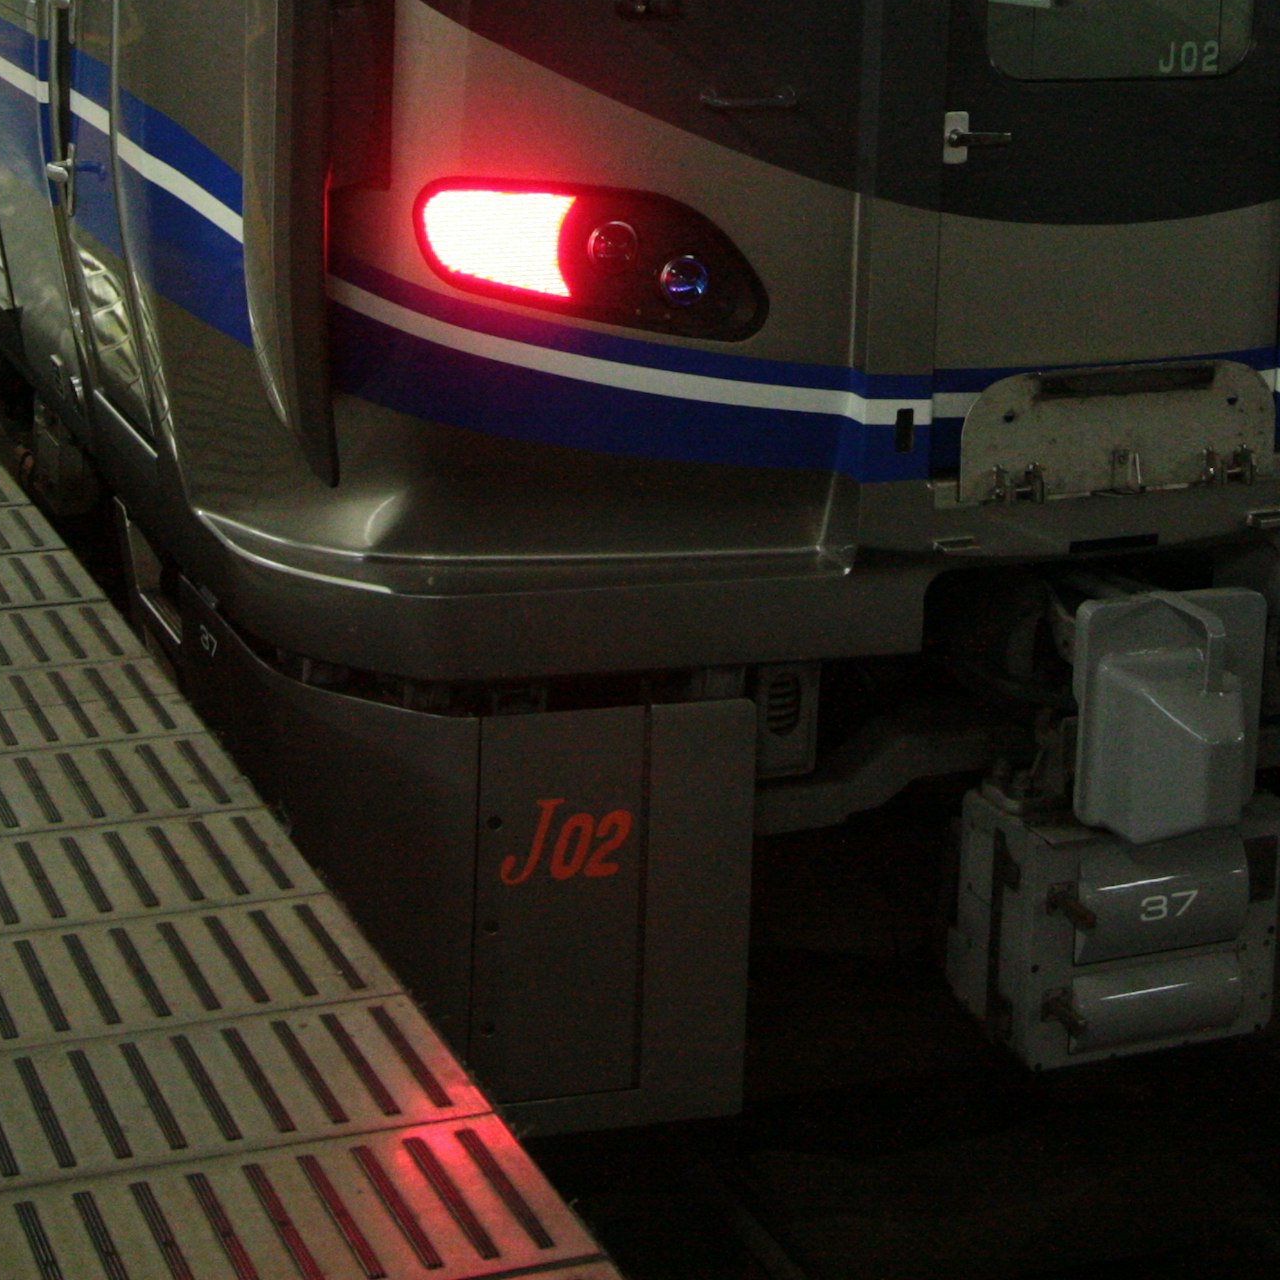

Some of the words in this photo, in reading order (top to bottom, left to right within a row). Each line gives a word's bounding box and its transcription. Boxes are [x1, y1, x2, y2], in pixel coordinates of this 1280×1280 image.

[1158, 39, 1219, 74] J02
[500, 797, 634, 886] J02
[1140, 889, 1199, 922] 37
